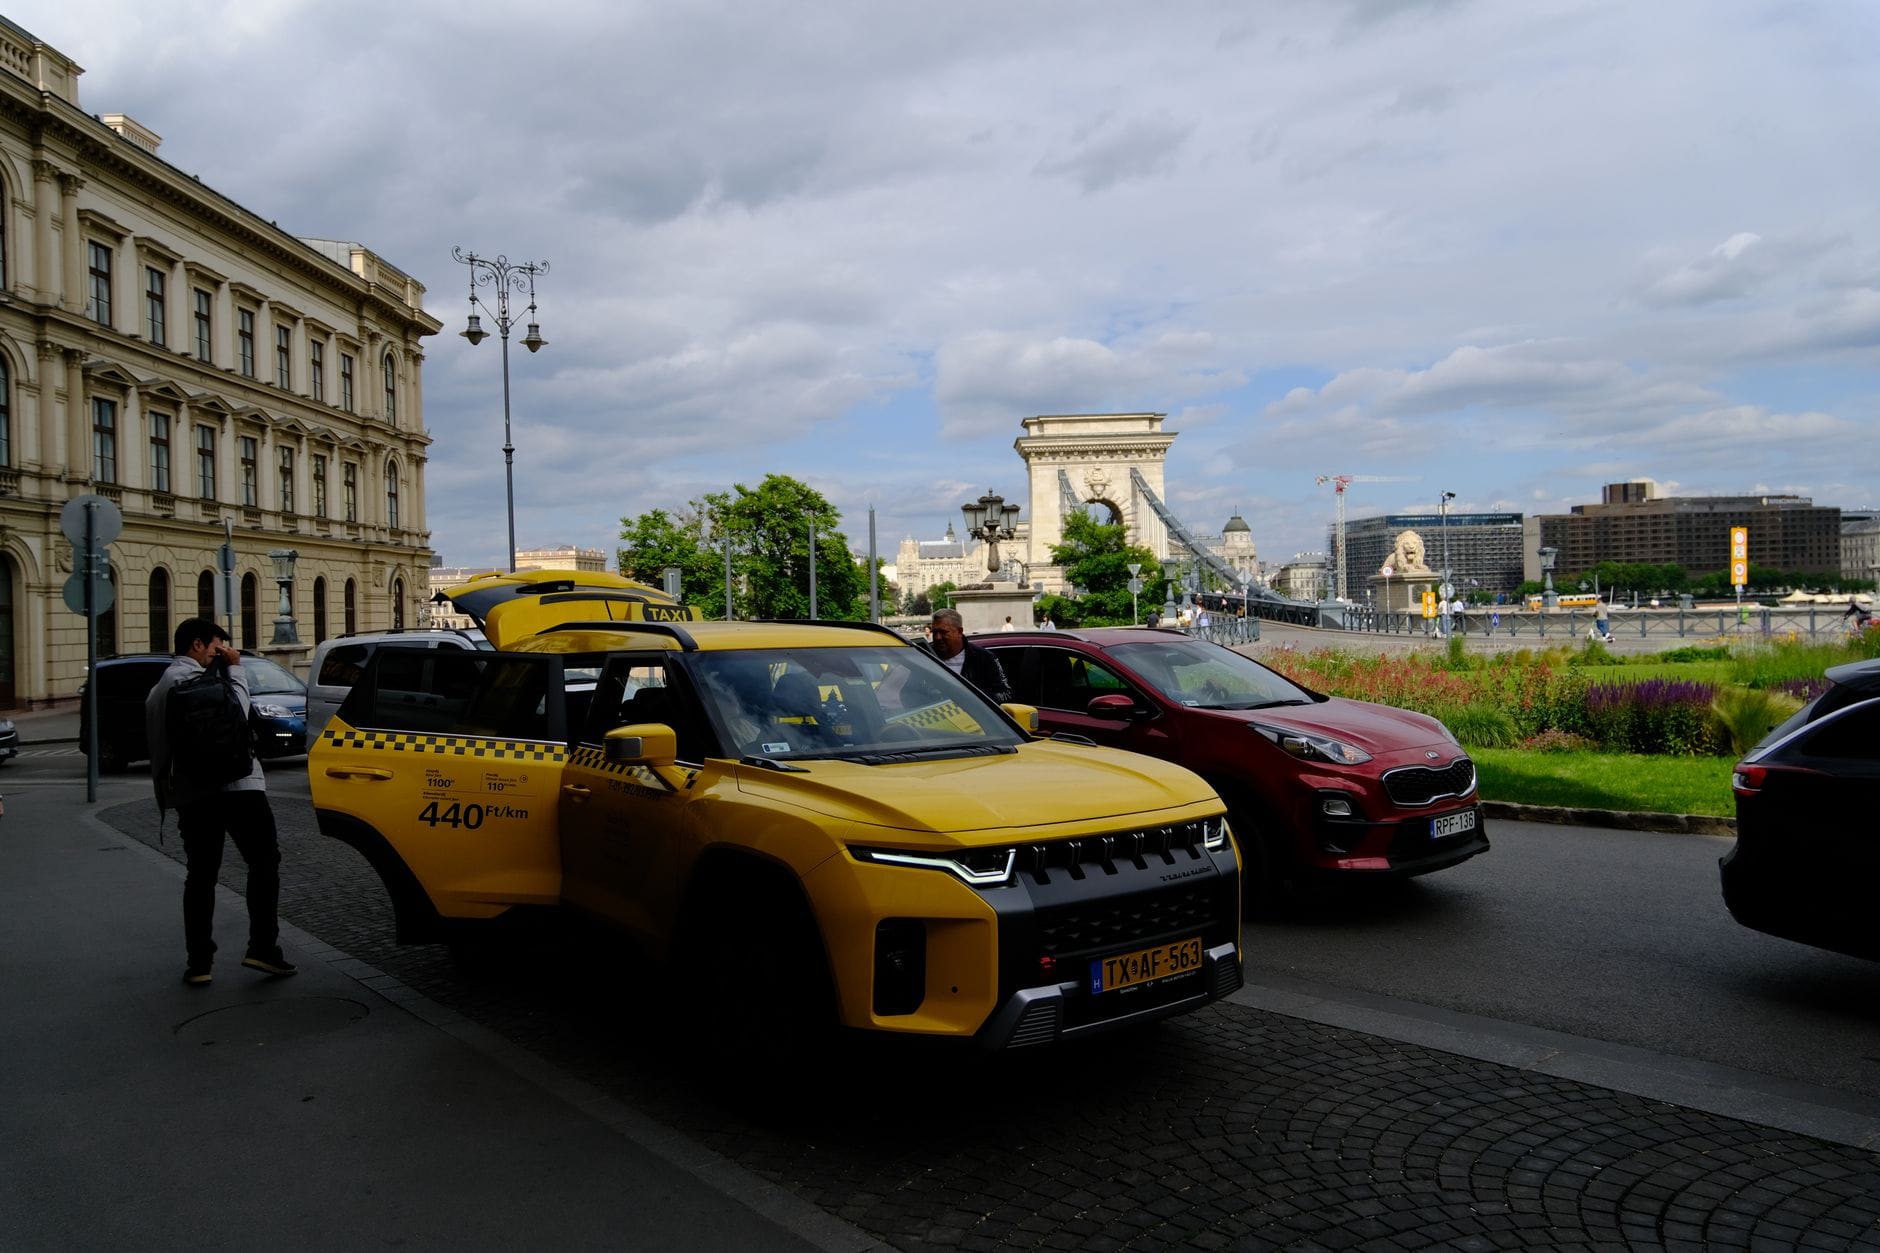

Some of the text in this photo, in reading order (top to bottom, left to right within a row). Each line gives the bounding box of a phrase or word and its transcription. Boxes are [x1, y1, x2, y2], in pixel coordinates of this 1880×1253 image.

[648, 607, 688, 623] TAXI
[428, 778, 451, 787] 1100
[487, 782, 504, 791] 110
[418, 801, 529, 830] 440 Ft/km
[1435, 812, 1474, 836] RPF-136
